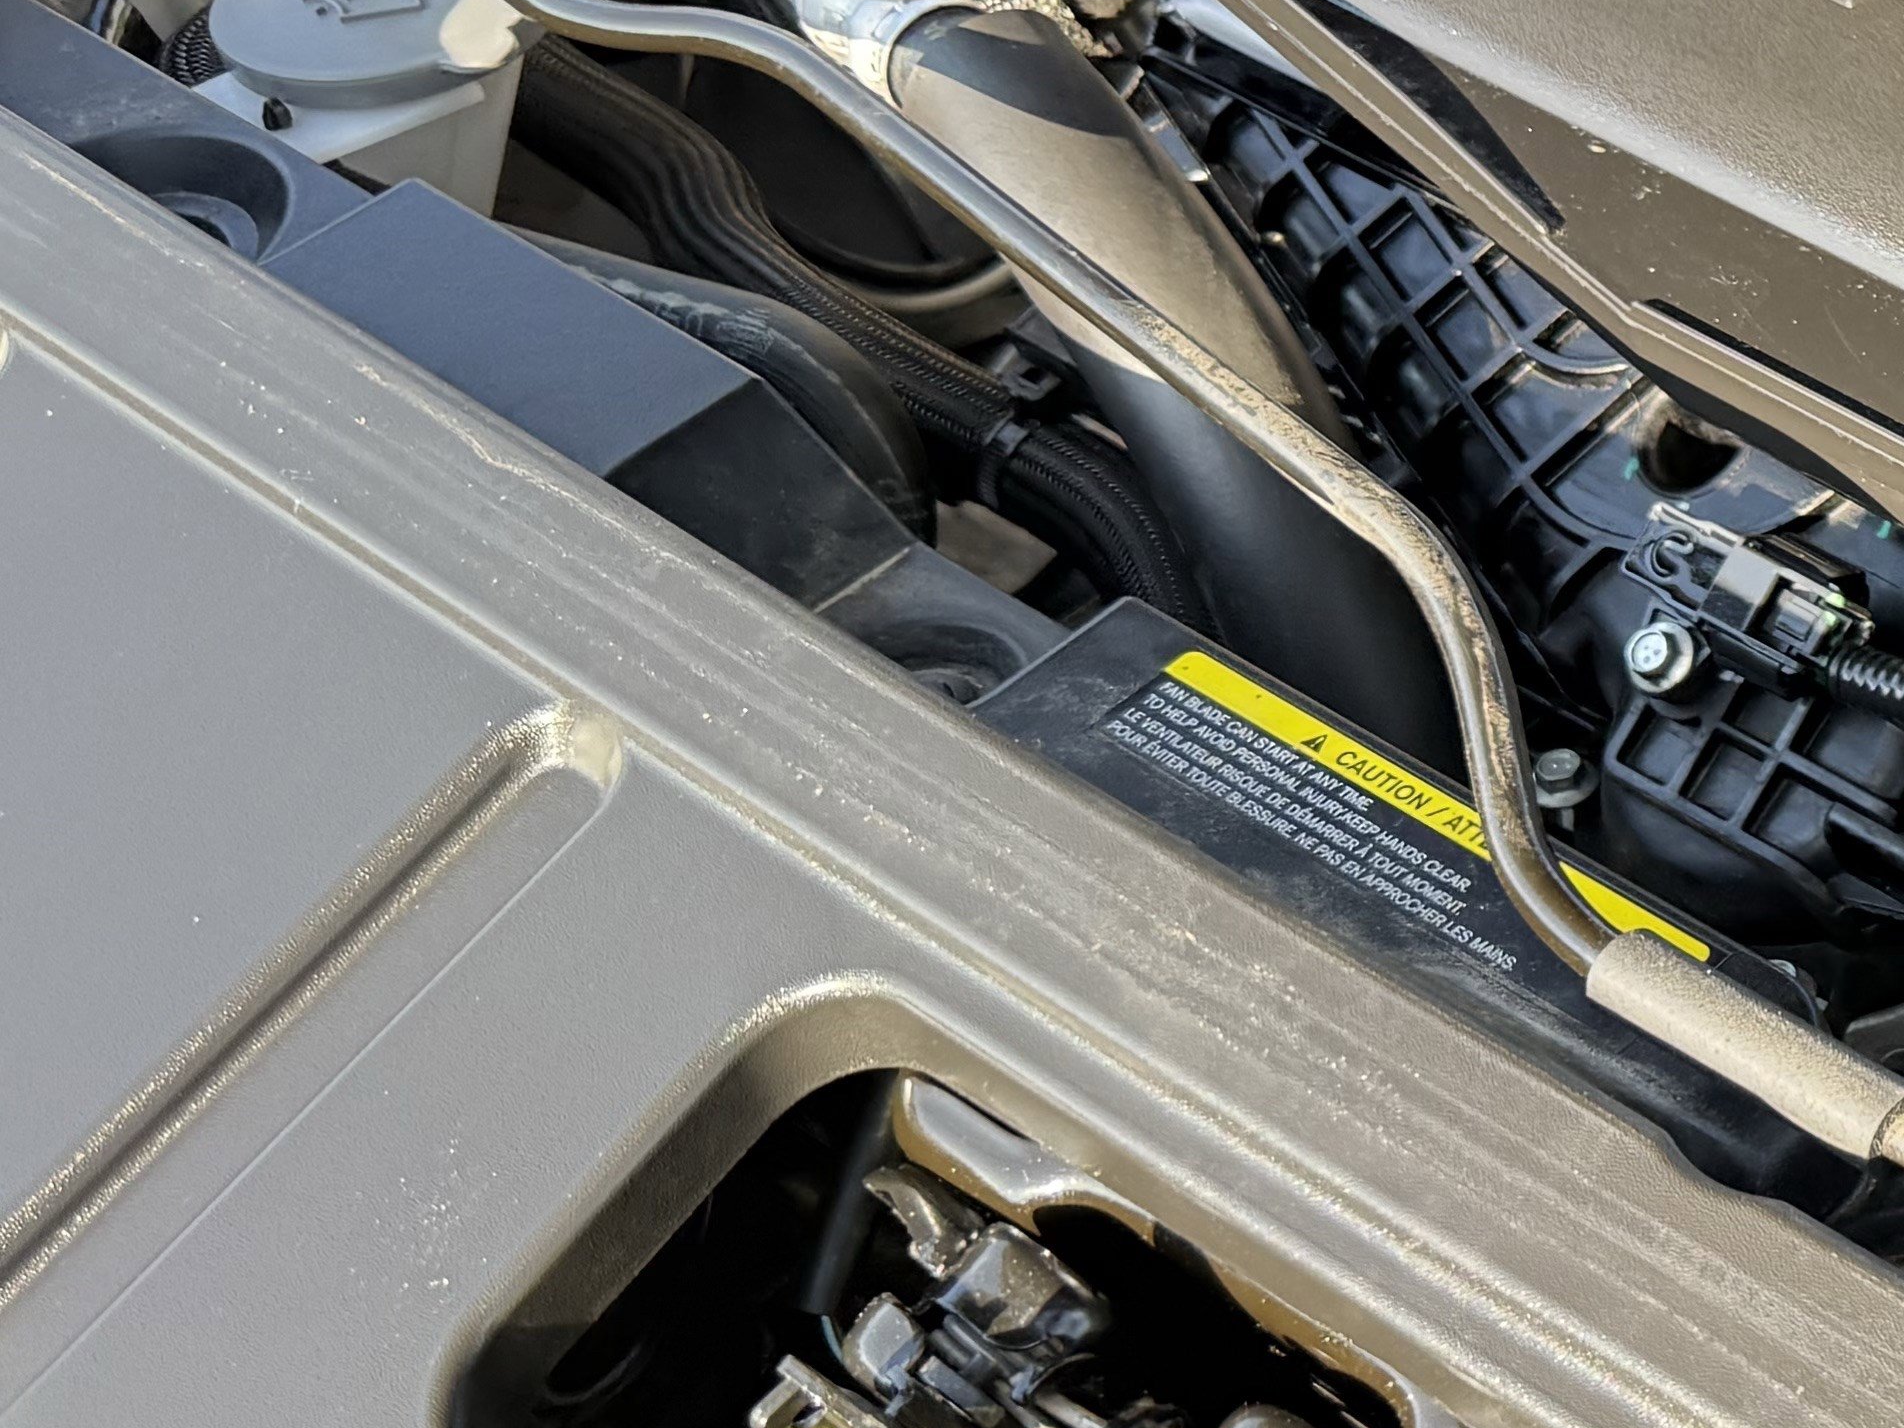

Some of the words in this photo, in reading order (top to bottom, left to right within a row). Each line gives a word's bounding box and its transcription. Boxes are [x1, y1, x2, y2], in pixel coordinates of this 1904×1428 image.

[1122, 707, 1146, 723] LE
[1141, 717, 1222, 768] VENTILATEUR
[1217, 763, 1270, 797] RISQUE
[1264, 791, 1290, 809] DE
[1284, 803, 1359, 850] DÉMARRER
[1353, 842, 1373, 858] À
[1367, 851, 1408, 877] TOUT
[1143, 692, 1165, 709] TO
[1160, 704, 1199, 726] HELP
[1192, 725, 1236, 751] AVOID
[1231, 746, 1300, 791] PERSONAL
[1374, 830, 1427, 864] HANDS
[1422, 859, 1471, 892] CLEAR.
[1158, 681, 1189, 701] FAN
[1183, 695, 1231, 725] BLADE
[1225, 720, 1258, 742] CAN
[1252, 737, 1299, 764] START
[1291, 760, 1315, 775] AT
[1307, 771, 1343, 790] ANY
[1335, 751, 1432, 809] CAUTION
[1424, 806, 1450, 817] /
[1105, 719, 1147, 747] POUR
[1141, 739, 1189, 772] ÉVITER
[1185, 766, 1231, 796] TOUTE
[1293, 831, 1319, 850] NE
[1312, 843, 1345, 865] PAS
[1339, 860, 1366, 878] EN
[1359, 873, 1446, 926] APPROCHER
[1441, 920, 1473, 943] LES
[1468, 936, 1516, 970] MAINS.
